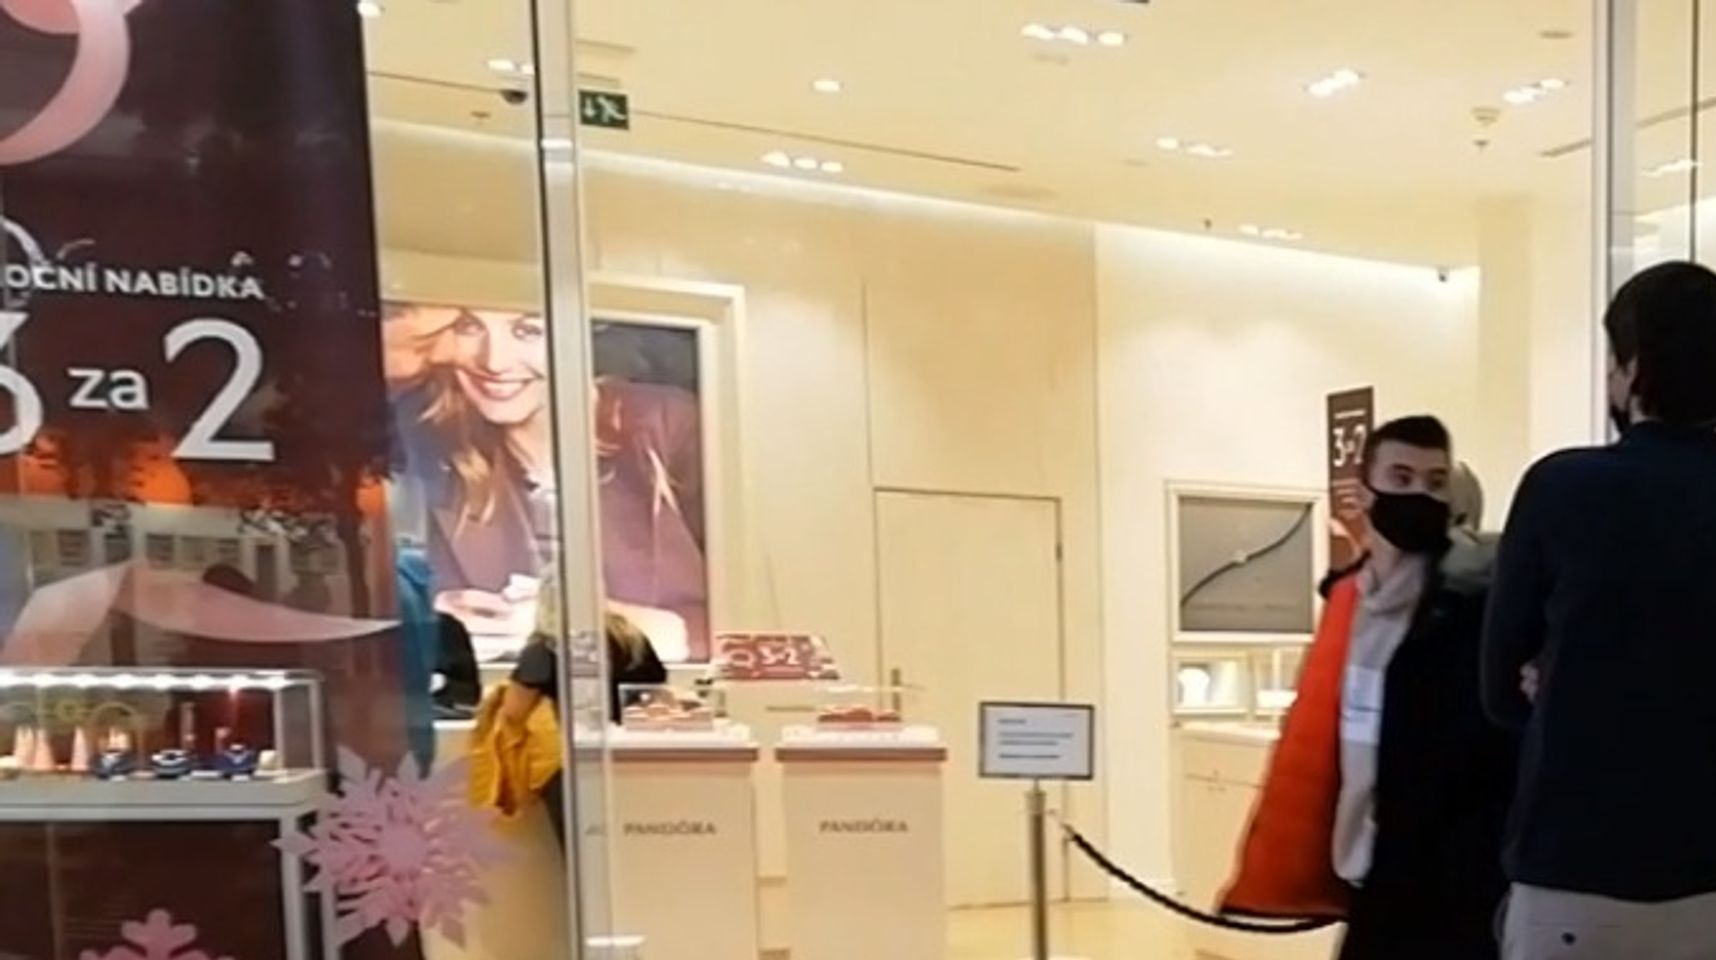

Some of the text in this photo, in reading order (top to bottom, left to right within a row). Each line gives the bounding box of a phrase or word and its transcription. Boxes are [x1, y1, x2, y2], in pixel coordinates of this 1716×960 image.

[104, 266, 264, 299] NABÍDKA
[66, 367, 150, 410] za
[163, 317, 275, 462] 2
